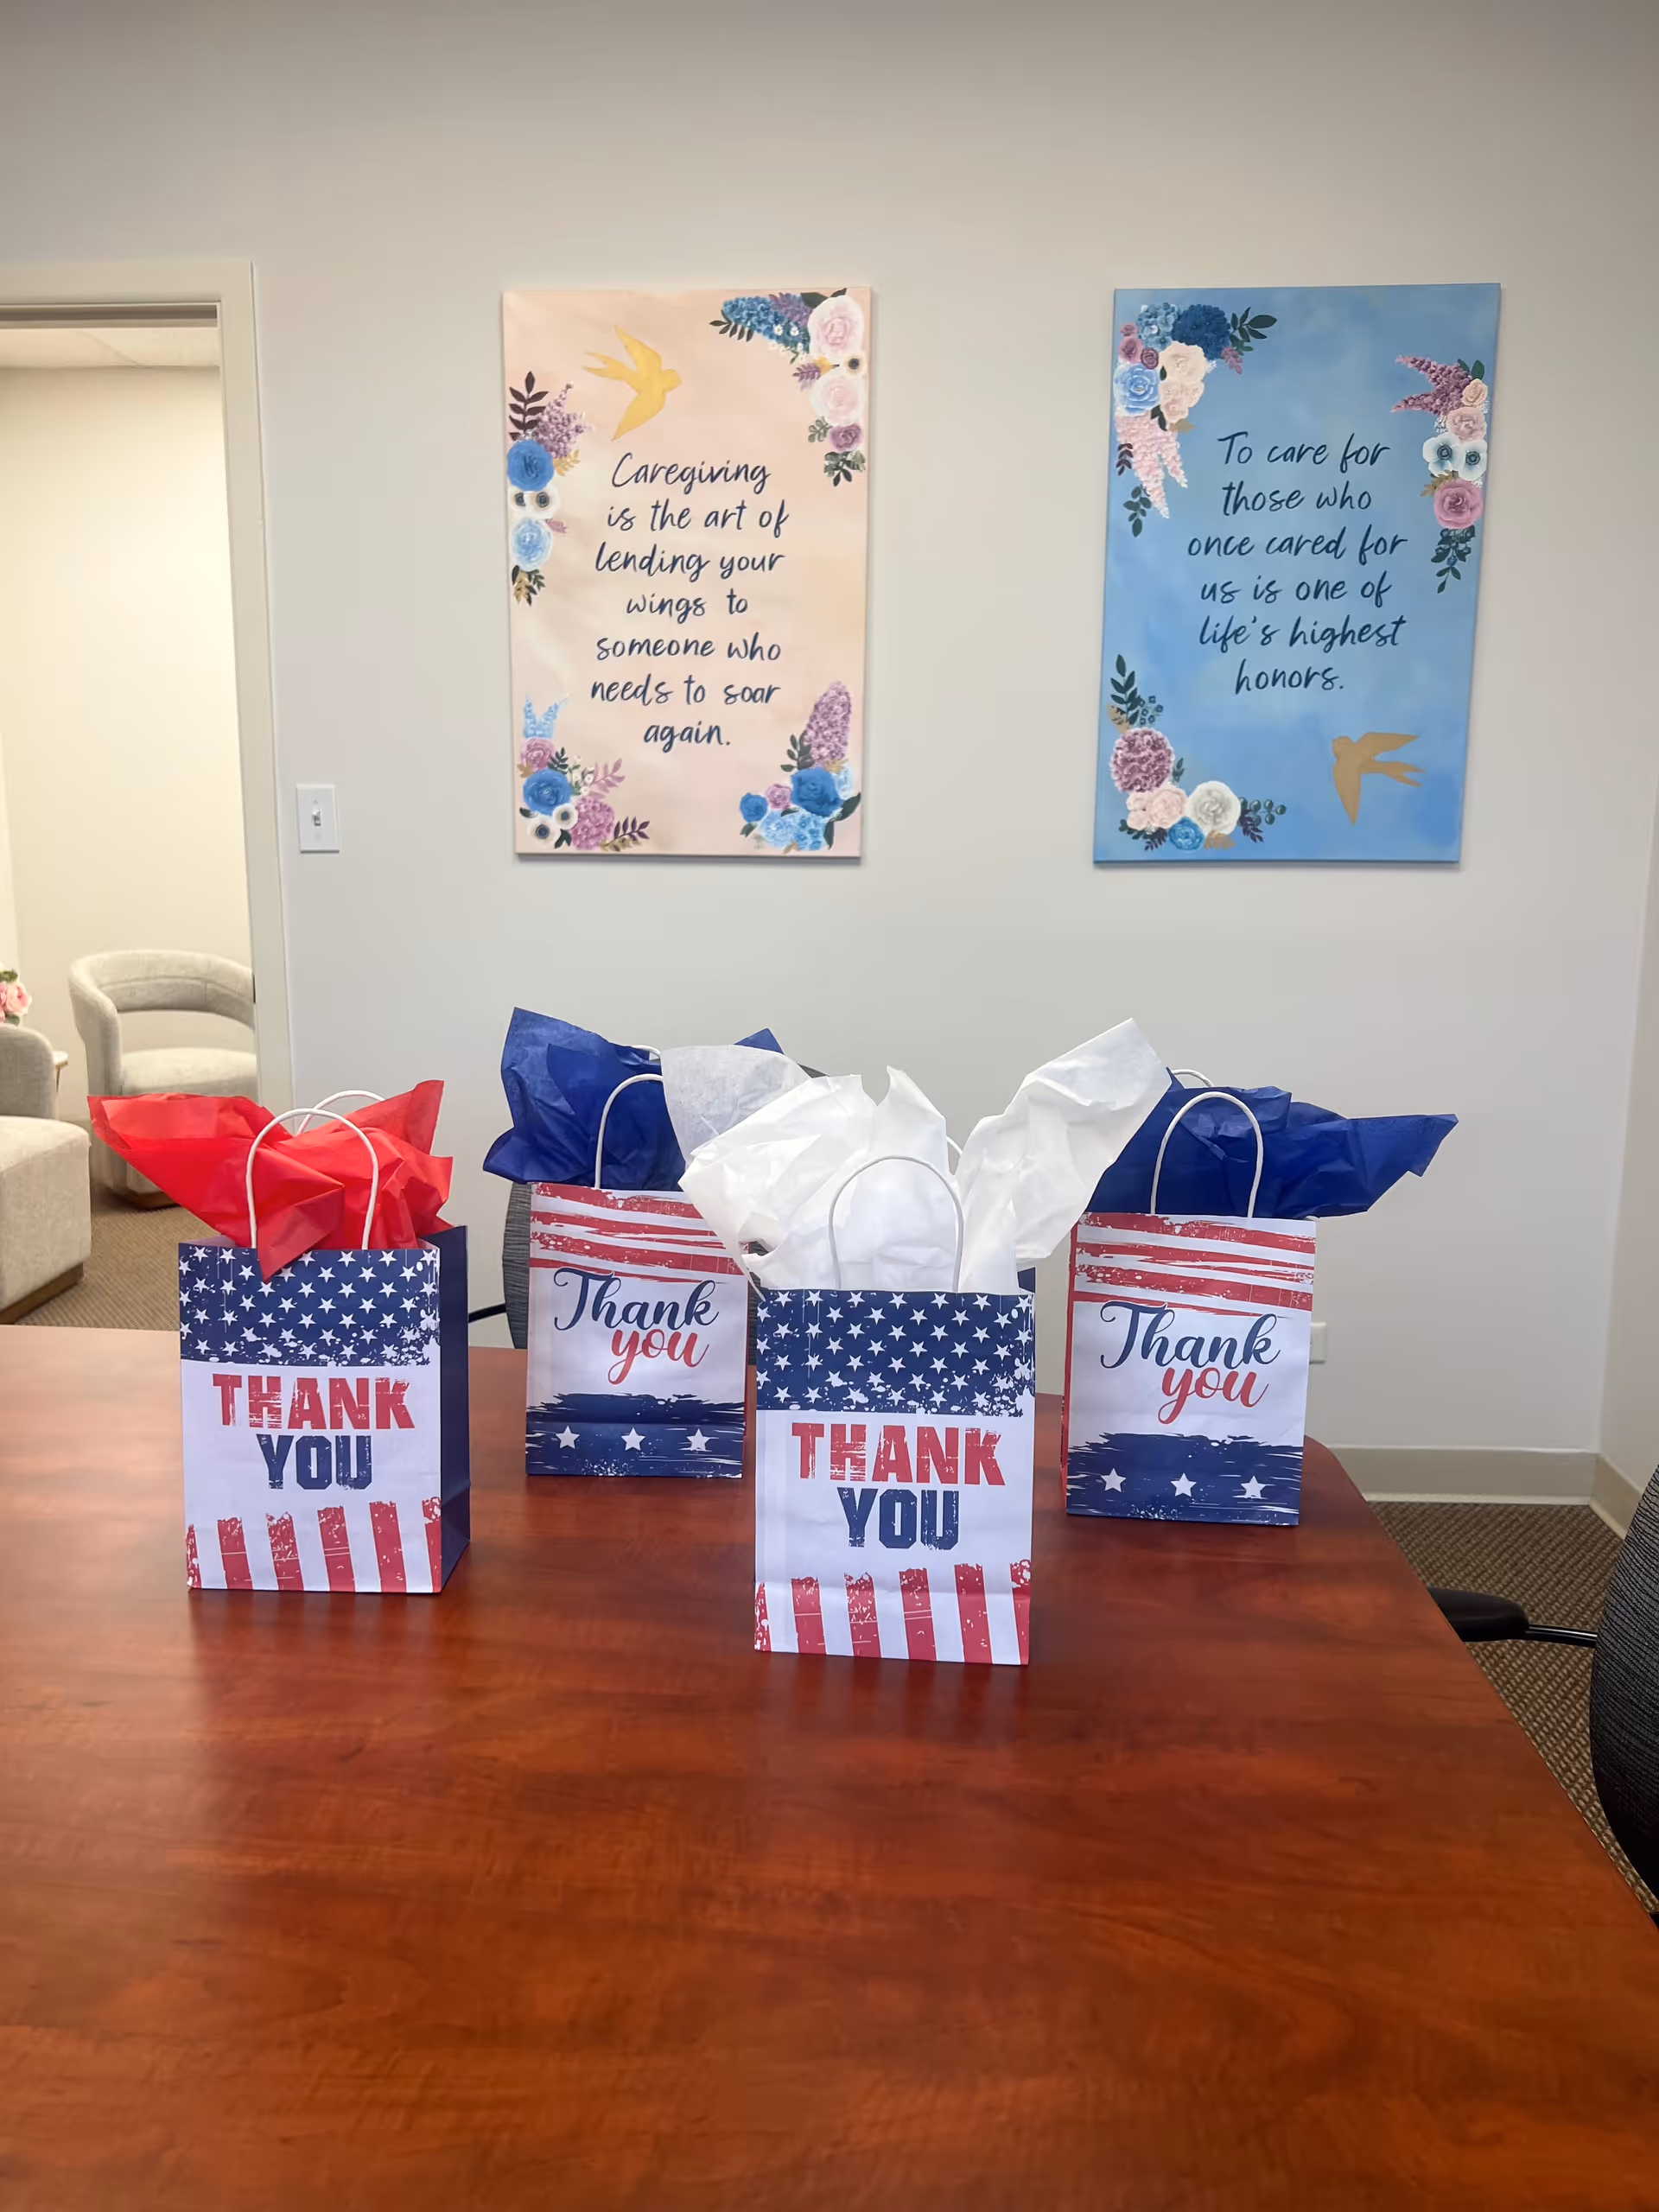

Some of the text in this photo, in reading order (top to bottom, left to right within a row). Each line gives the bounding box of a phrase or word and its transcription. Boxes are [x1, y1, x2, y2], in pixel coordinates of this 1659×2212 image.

[612, 452, 771, 494] Caregiving
[1217, 432, 1391, 473] To care for
[607, 498, 789, 537] is the art of
[1222, 480, 1371, 515] those who
[594, 542, 785, 582] lending your
[1187, 525, 1408, 566] once cared for
[626, 588, 748, 624] wings to
[1200, 570, 1392, 607] us is one of
[596, 632, 781, 661] someone who
[1198, 615, 1407, 653] life's highest
[591, 673, 780, 705] needs to soar
[1235, 659, 1344, 695] honors.
[644, 721, 730, 752] again.
[553, 1268, 719, 1331] Thank
[1101, 1301, 1281, 1369] Thank
[607, 1328, 709, 1384] you
[213, 1374, 415, 1429] THANK
[1158, 1366, 1268, 1424] you
[256, 1433, 372, 1490] YOU
[791, 1422, 1006, 1485] THANK
[836, 1487, 959, 1549] YOU
